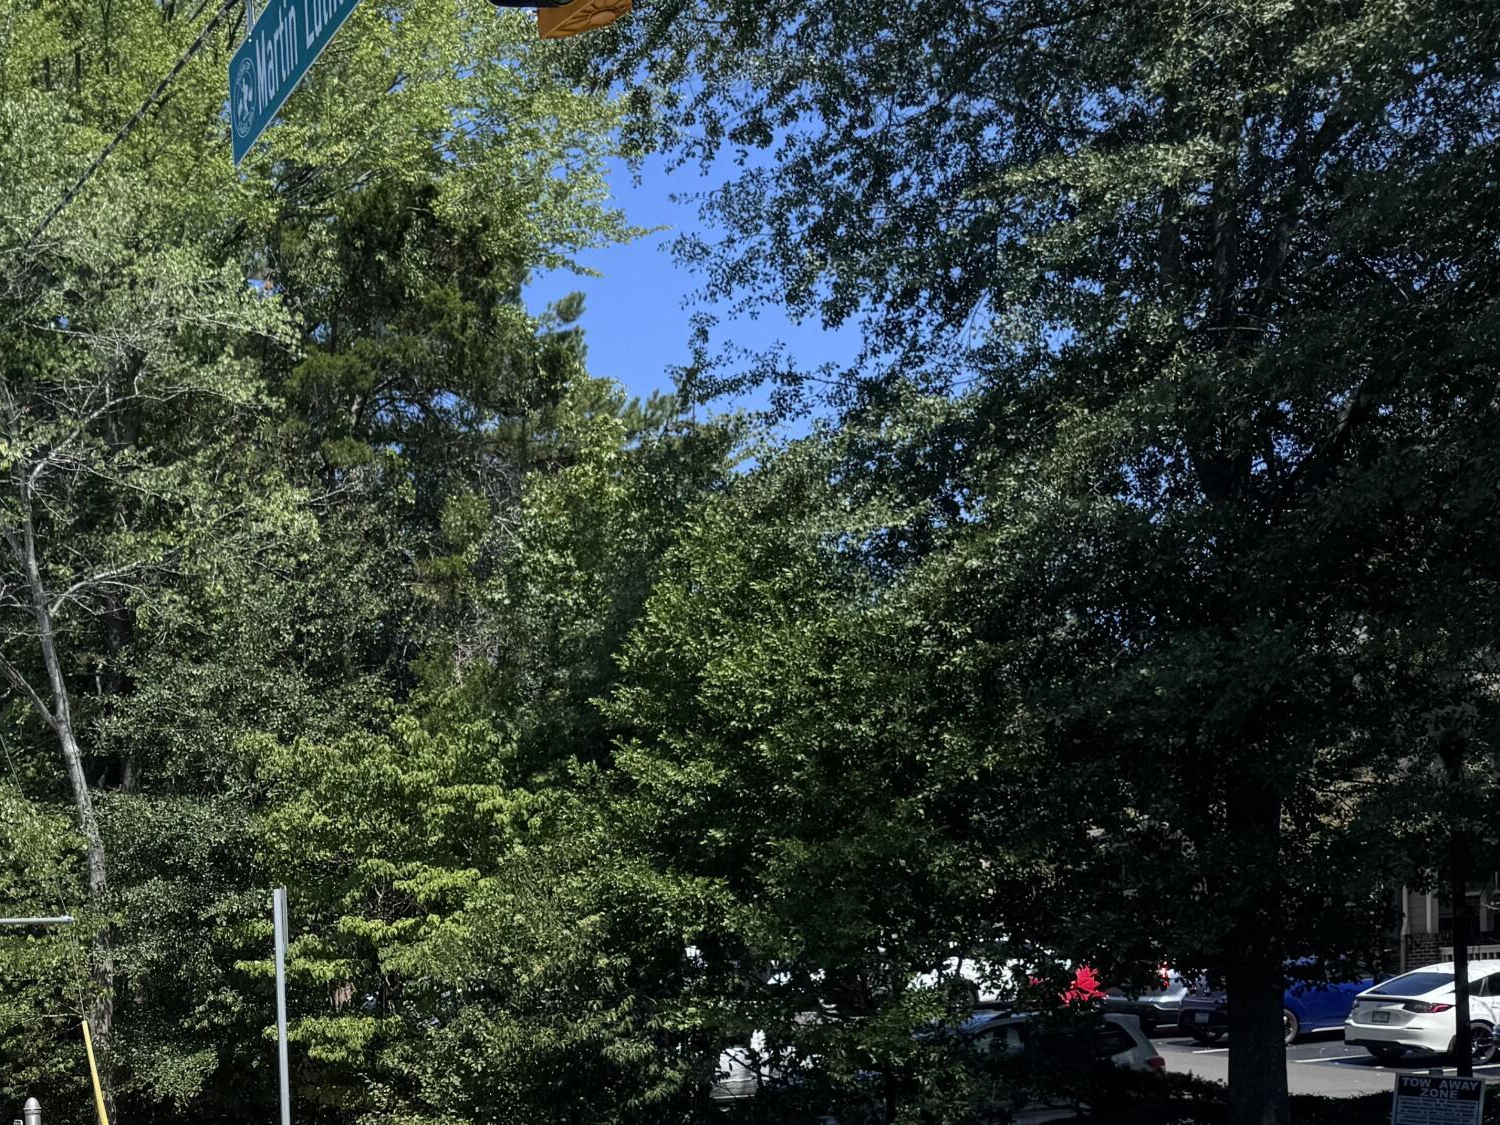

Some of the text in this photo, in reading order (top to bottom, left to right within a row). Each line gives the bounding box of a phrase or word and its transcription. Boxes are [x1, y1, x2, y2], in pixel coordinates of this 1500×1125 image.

[255, 0, 298, 115] Martin
[1401, 1077, 1479, 1091] TOW AWAY
[1419, 1087, 1459, 1099] ZONE
